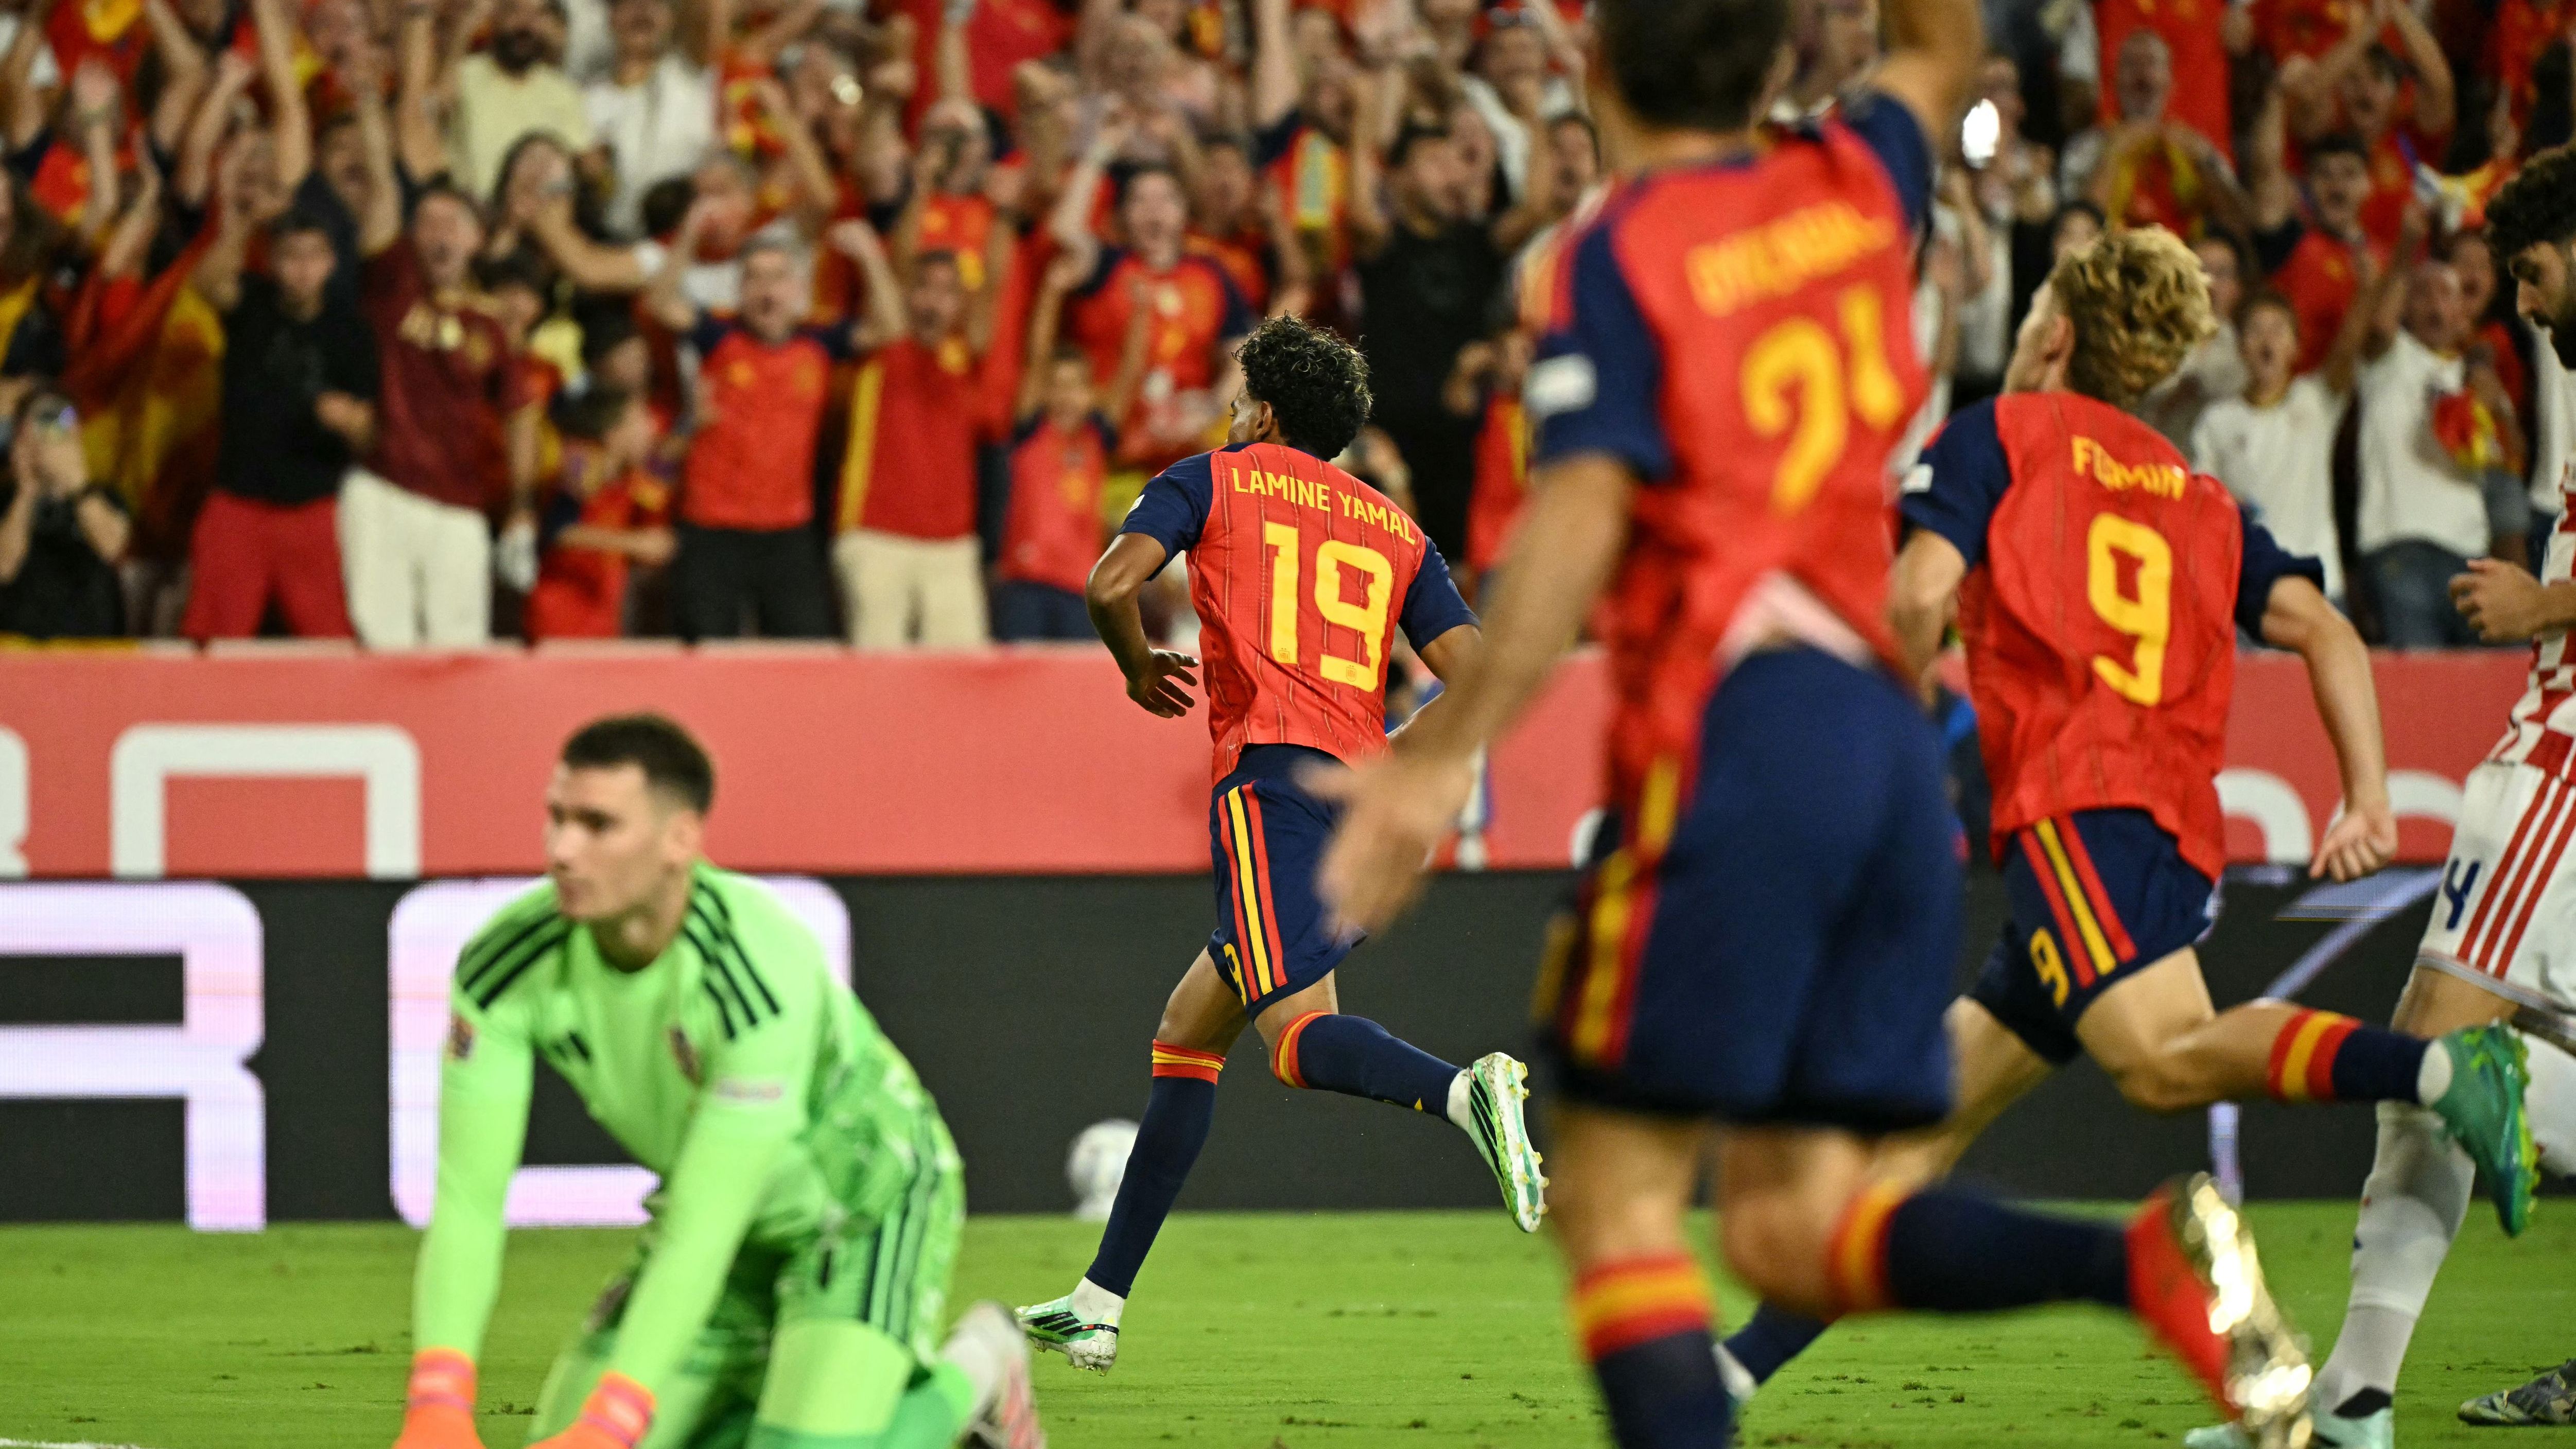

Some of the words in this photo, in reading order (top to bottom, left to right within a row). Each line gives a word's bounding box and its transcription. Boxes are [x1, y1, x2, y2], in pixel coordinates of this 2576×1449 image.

[1232, 467, 1331, 512] LAMINE
[1337, 490, 1416, 545] YAMAL
[1264, 521, 1393, 692] 19
[2087, 512, 2173, 707] 9
[2444, 857, 2481, 931] 4
[2030, 927, 2070, 1008] 9
